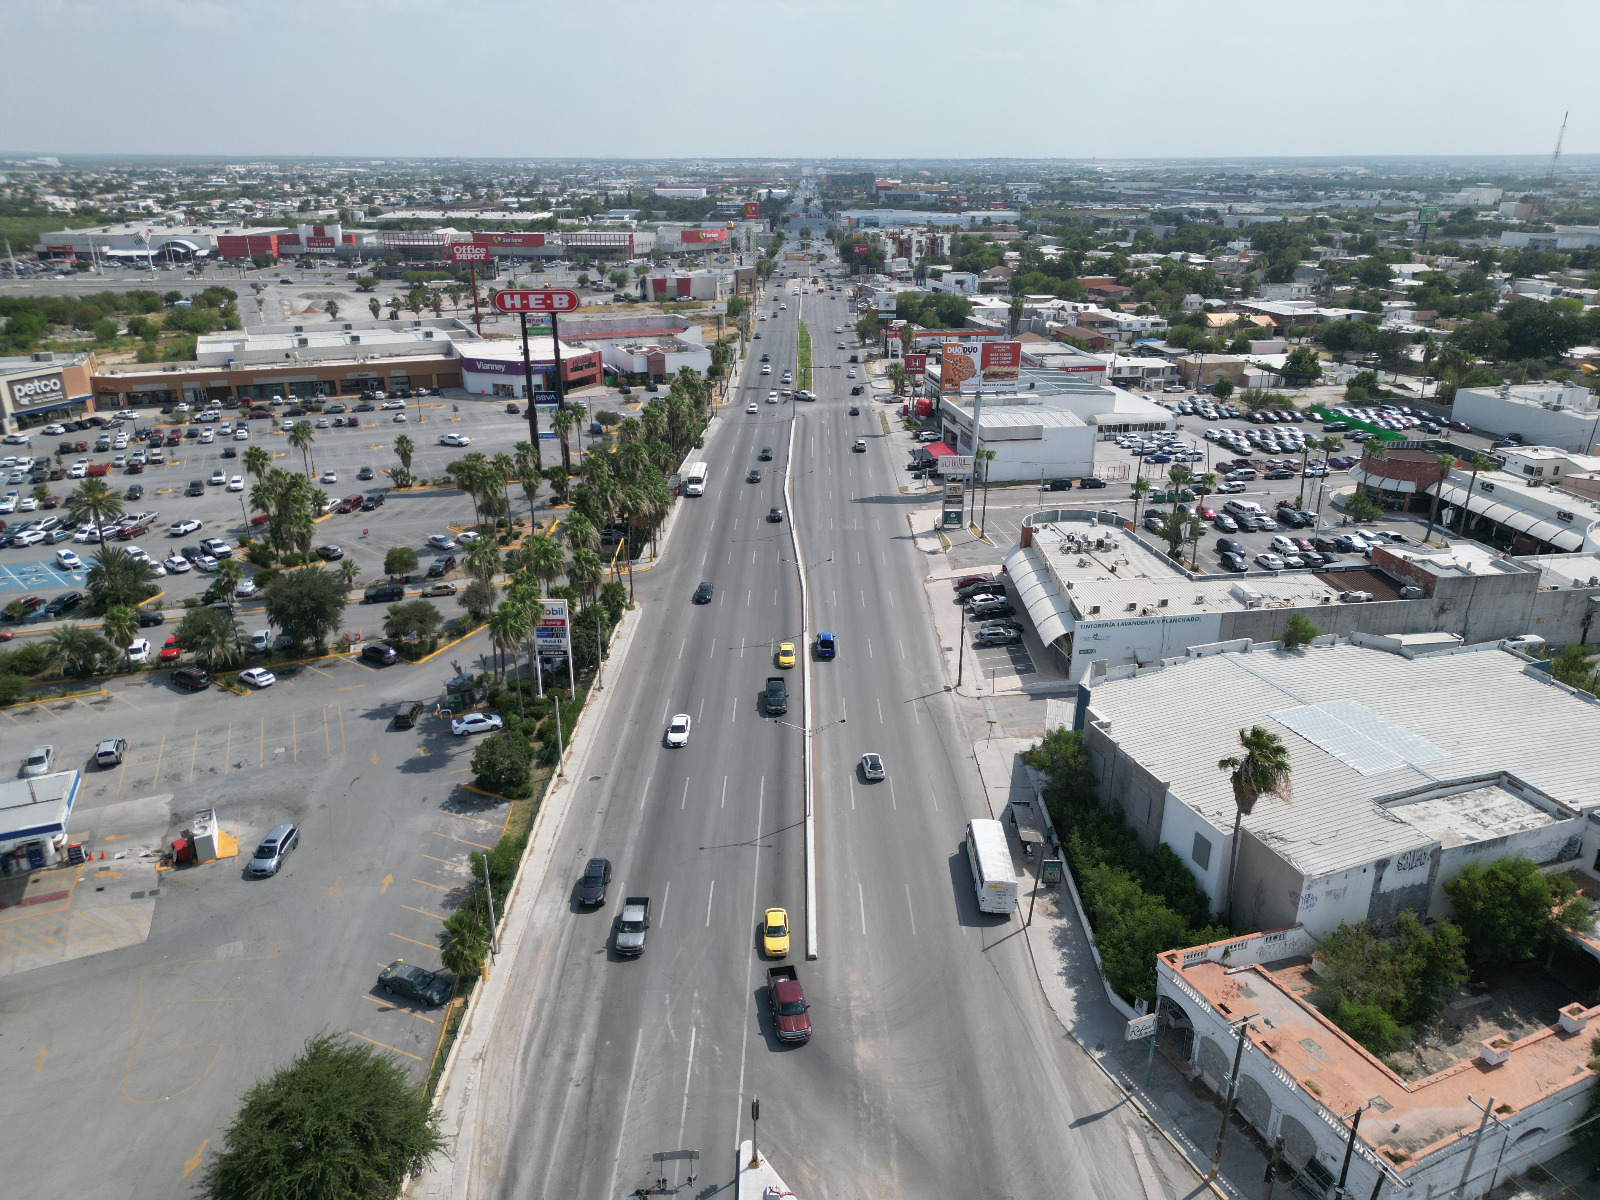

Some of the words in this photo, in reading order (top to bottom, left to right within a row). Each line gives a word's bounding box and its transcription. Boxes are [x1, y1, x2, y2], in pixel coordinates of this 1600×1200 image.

[453, 245, 486, 254] Office
[476, 361, 506, 373] Vianney
[13, 378, 61, 401] petco
[542, 607, 564, 616] obil
[1080, 621, 1116, 630] TINTORERÍA
[1117, 618, 1155, 627] LAVANDERÍA
